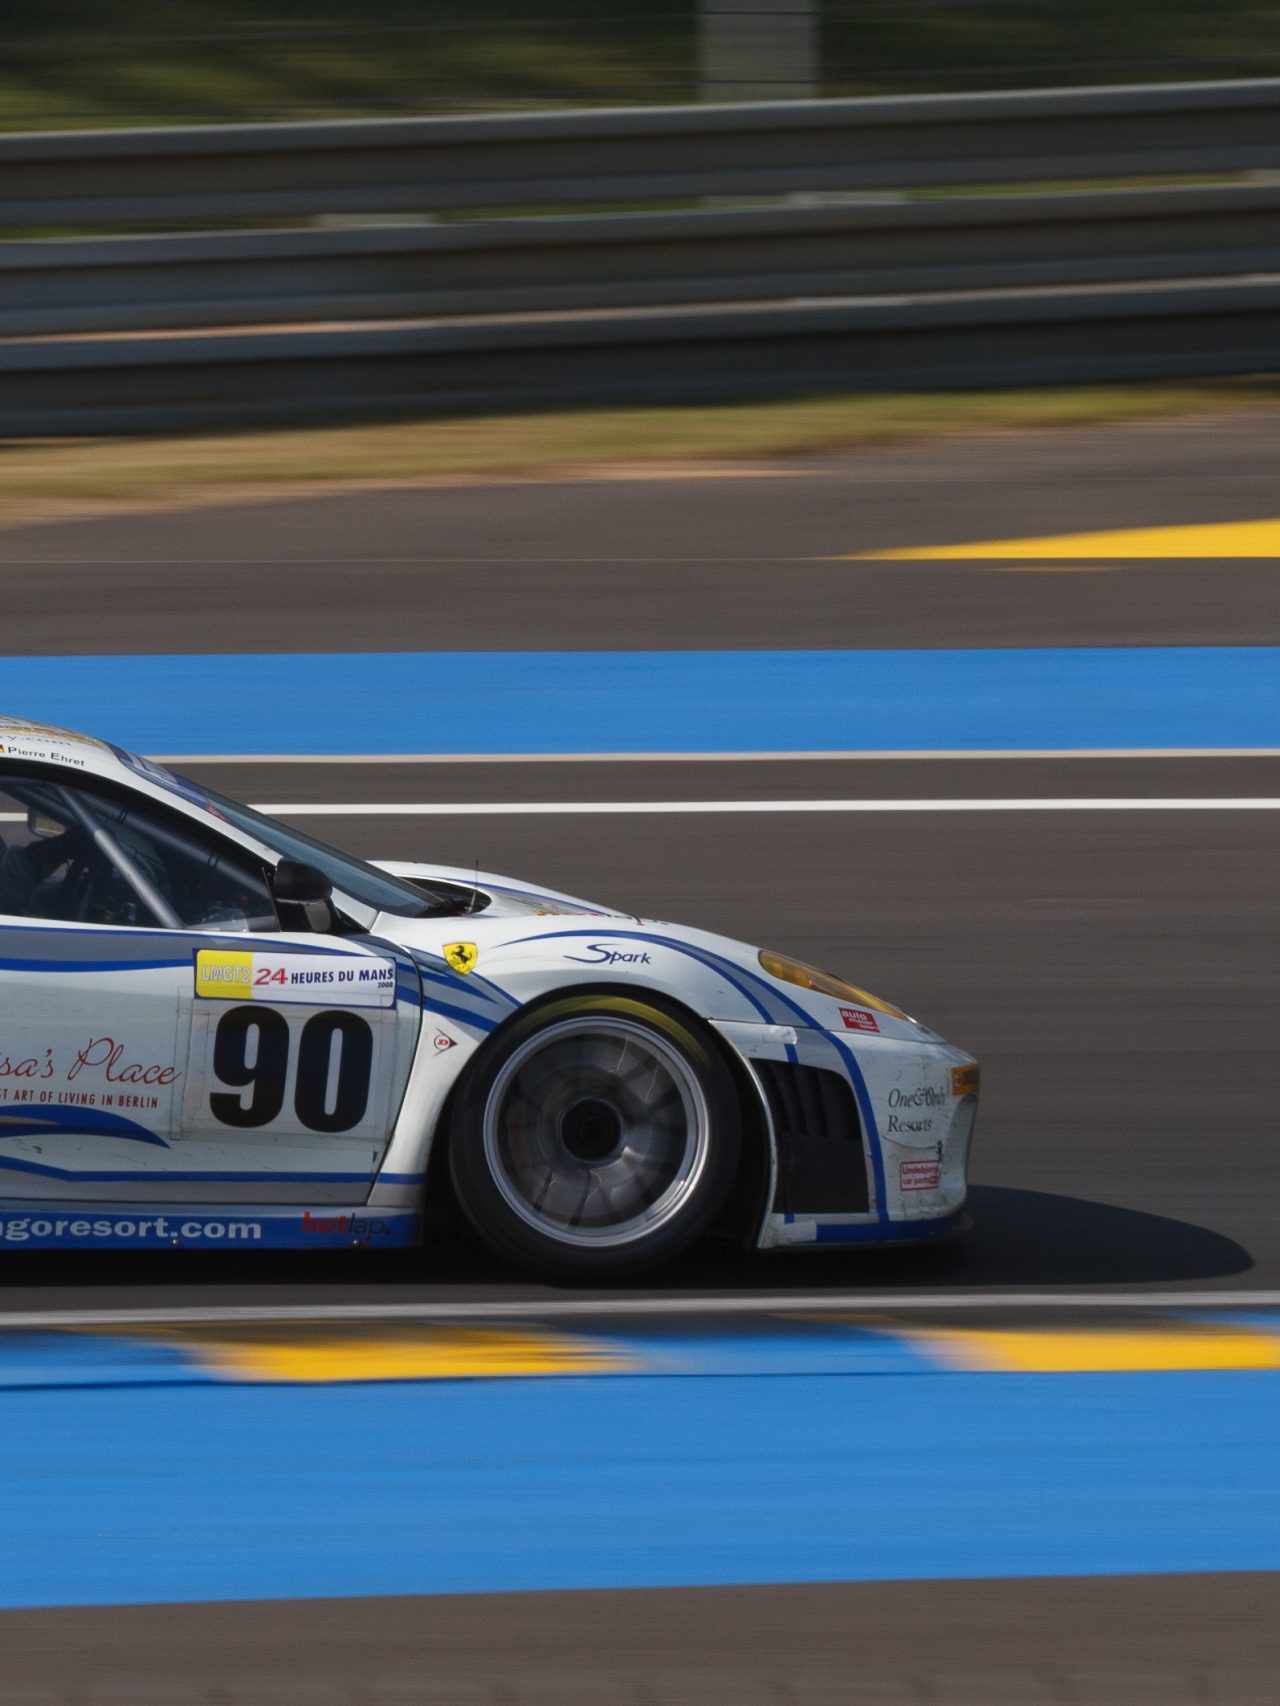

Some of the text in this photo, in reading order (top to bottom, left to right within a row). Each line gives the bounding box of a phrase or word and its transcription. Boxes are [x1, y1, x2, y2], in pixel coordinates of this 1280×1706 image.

[8, 746, 85, 767] Pierre Ehret
[563, 943, 652, 965] Spark
[201, 965, 250, 984] LMGT2
[253, 967, 394, 986] 24 HEURES DU MANS
[377, 981, 394, 989] 2008
[67, 1036, 182, 1086] Place
[209, 1005, 374, 1133] 90
[14, 1089, 34, 1102] ART
[39, 1090, 54, 1103] OF
[58, 1092, 96, 1105] LIVING
[102, 1094, 113, 1106] IN
[118, 1095, 158, 1109] BERLIN
